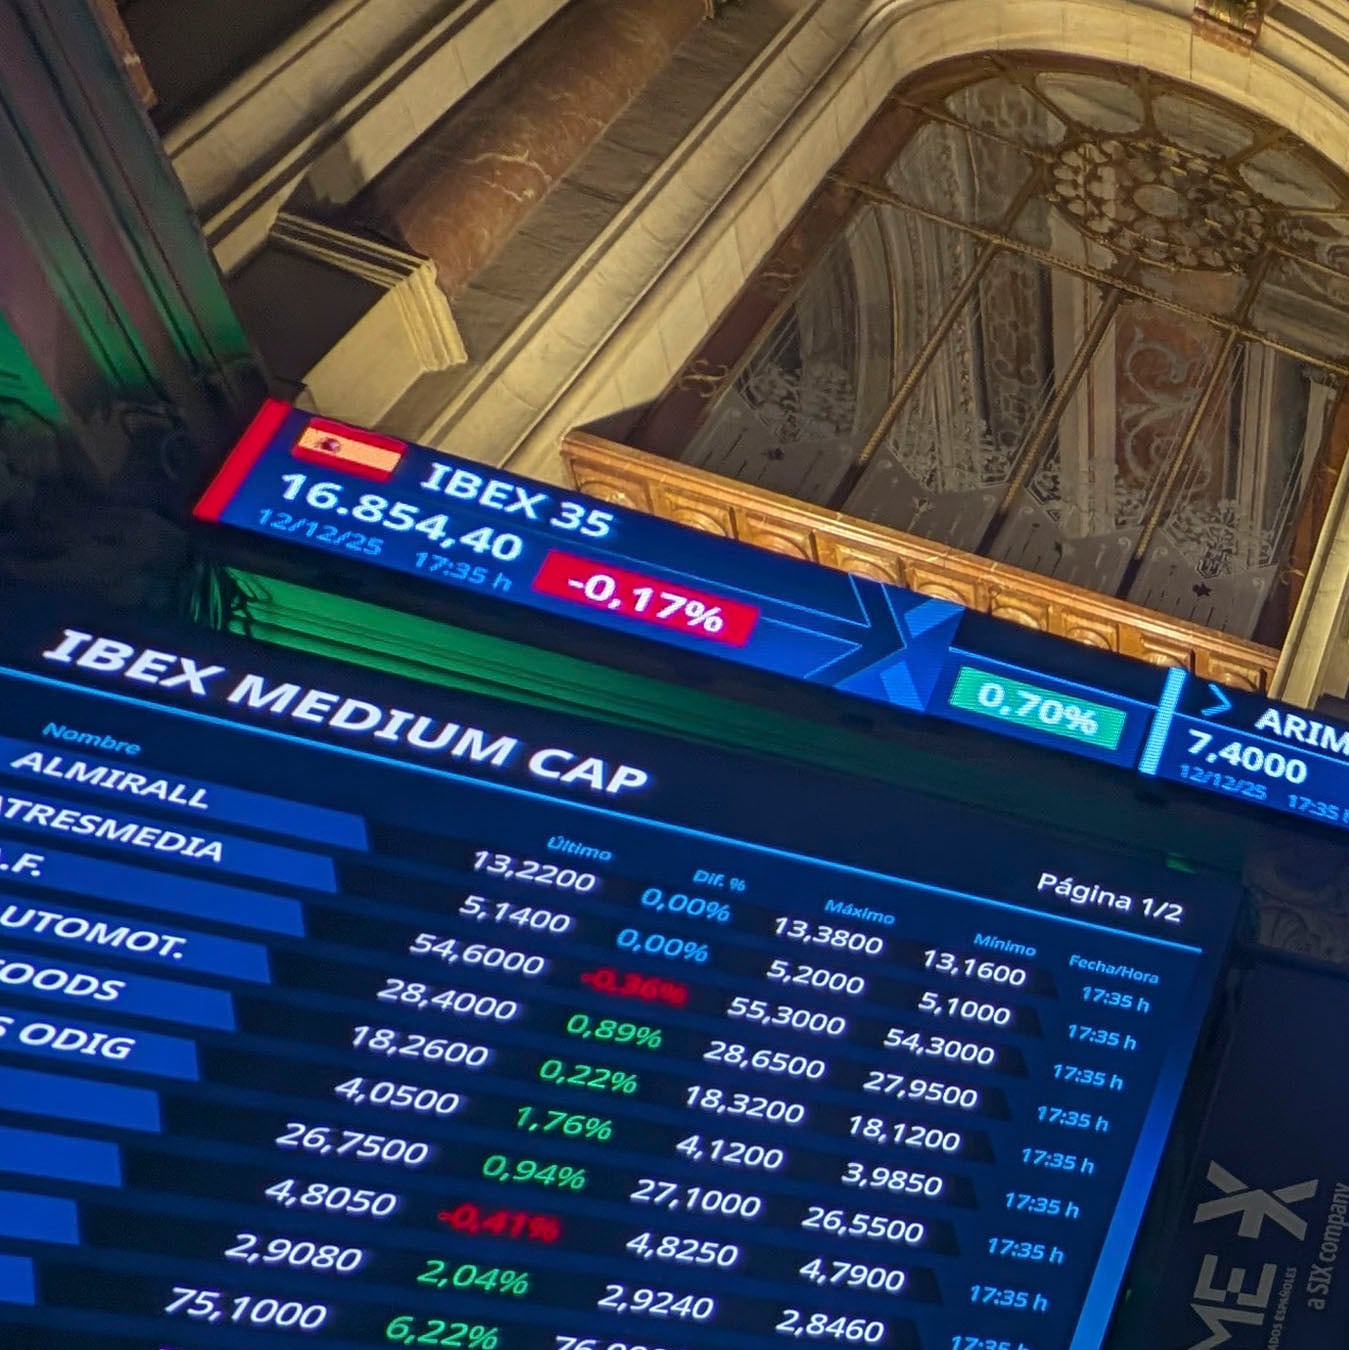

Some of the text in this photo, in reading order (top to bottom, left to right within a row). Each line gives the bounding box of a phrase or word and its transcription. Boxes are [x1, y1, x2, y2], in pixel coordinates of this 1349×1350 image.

[283, 474, 522, 561] 16.854,40
[421, 463, 613, 537] IBEX 35
[259, 509, 512, 592] 12/12/25 17:35 h
[569, 575, 722, 632] -0,17%
[43, 630, 647, 793] IBEX MEDIUM CAP
[978, 682, 1097, 736] 0,70%
[1189, 729, 1307, 783] 7,4000
[0, 796, 222, 862] TRESMEDIA
[43, 723, 1159, 984] Nombre Último Máximo Mínimo Fecha/Hora
[11, 752, 1026, 985] ALMIRALL 13,2200 0,00% 13,3800 13,1600
[1038, 873, 1182, 922] Página 1/2
[0, 906, 186, 958] UTOMOT.
[0, 959, 126, 1001] OODS
[19, 1022, 136, 1059] ODIG
[377, 979, 977, 1107] 28,4000 0,89% 28,6500 27,9500
[276, 1123, 923, 1243] 26,7500 0,94% 27,1000 26,5500
[1308, 1265, 1333, 1297] SIX
[1308, 1298, 1326, 1311] a
[165, 1288, 326, 1328] 75,1000
[386, 1316, 498, 1350] 6,22%
